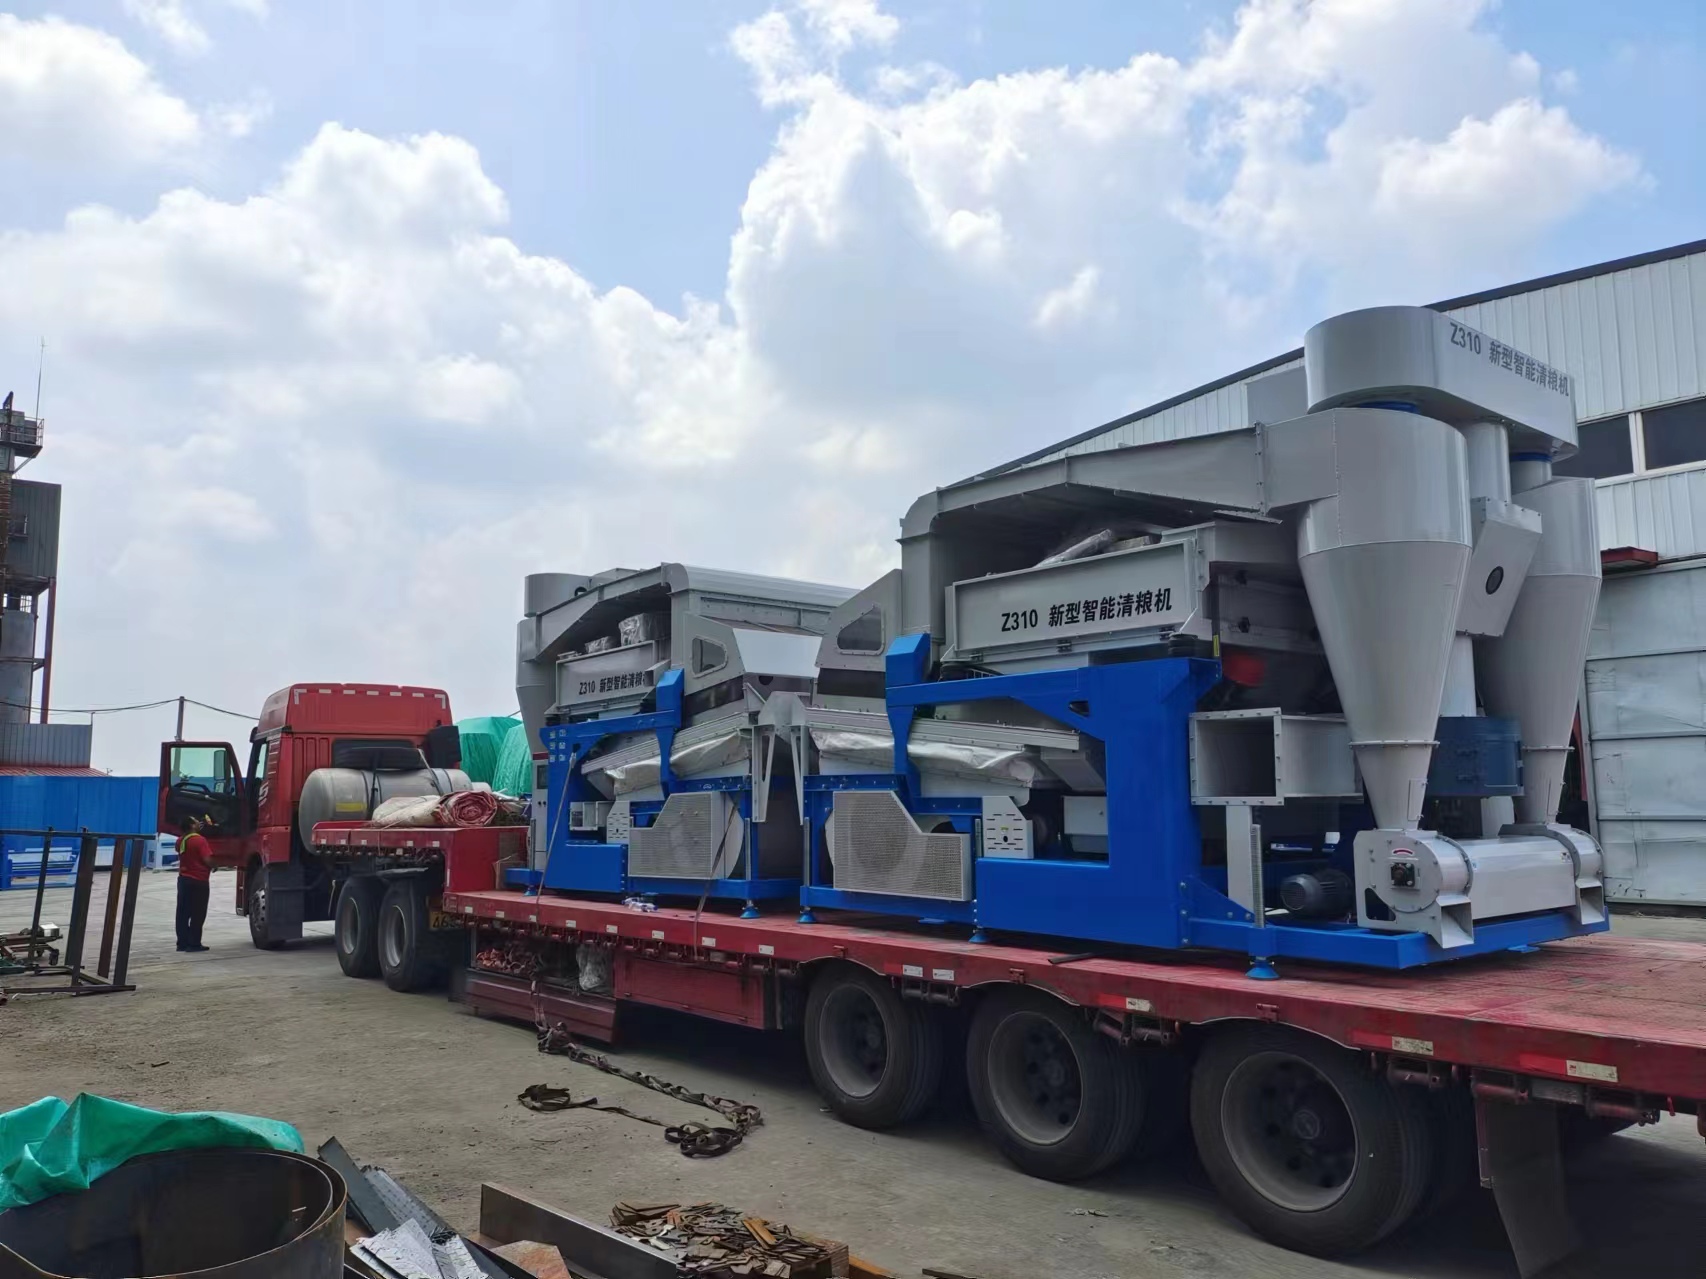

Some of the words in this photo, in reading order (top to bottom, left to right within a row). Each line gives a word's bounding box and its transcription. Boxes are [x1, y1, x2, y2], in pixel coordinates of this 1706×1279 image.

[1450, 322, 1481, 355] Z310
[1489, 341, 1569, 397] 新型智能清粮机
[1001, 609, 1038, 632] Z310
[1048, 588, 1172, 627] 新型智能清粮机
[579, 680, 596, 696] Z310
[599, 671, 646, 693] 新型智能清粮
